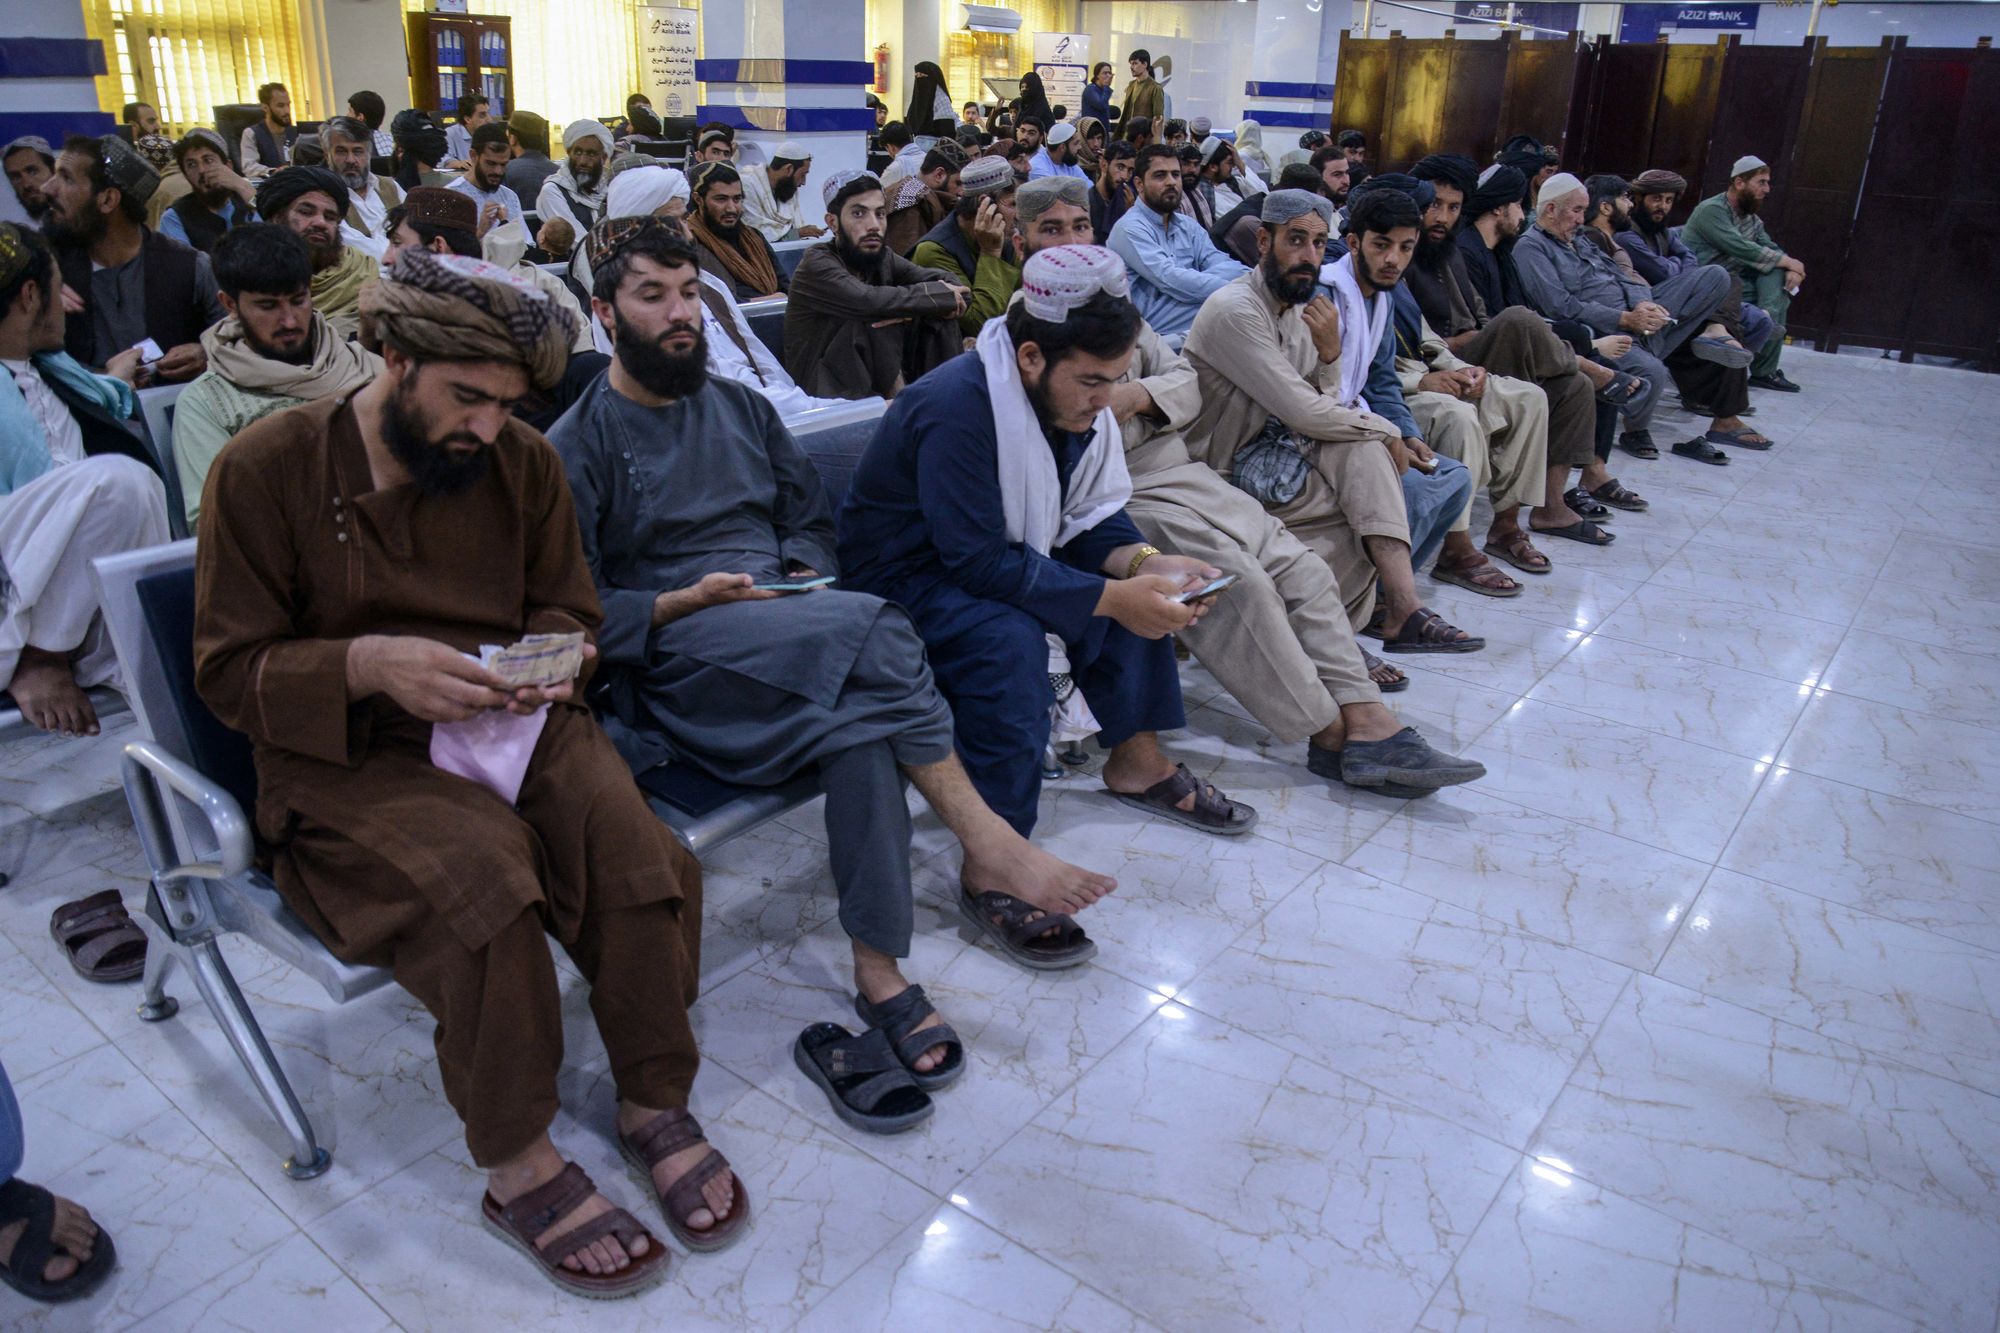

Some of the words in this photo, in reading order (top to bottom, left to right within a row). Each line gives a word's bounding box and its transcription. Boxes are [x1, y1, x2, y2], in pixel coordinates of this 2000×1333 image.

[1468, 8, 1493, 17] AZIZI
[1494, 8, 1524, 17] BAK
[1677, 9, 1707, 20] AZIZI
[1708, 10, 1743, 21] BANK
